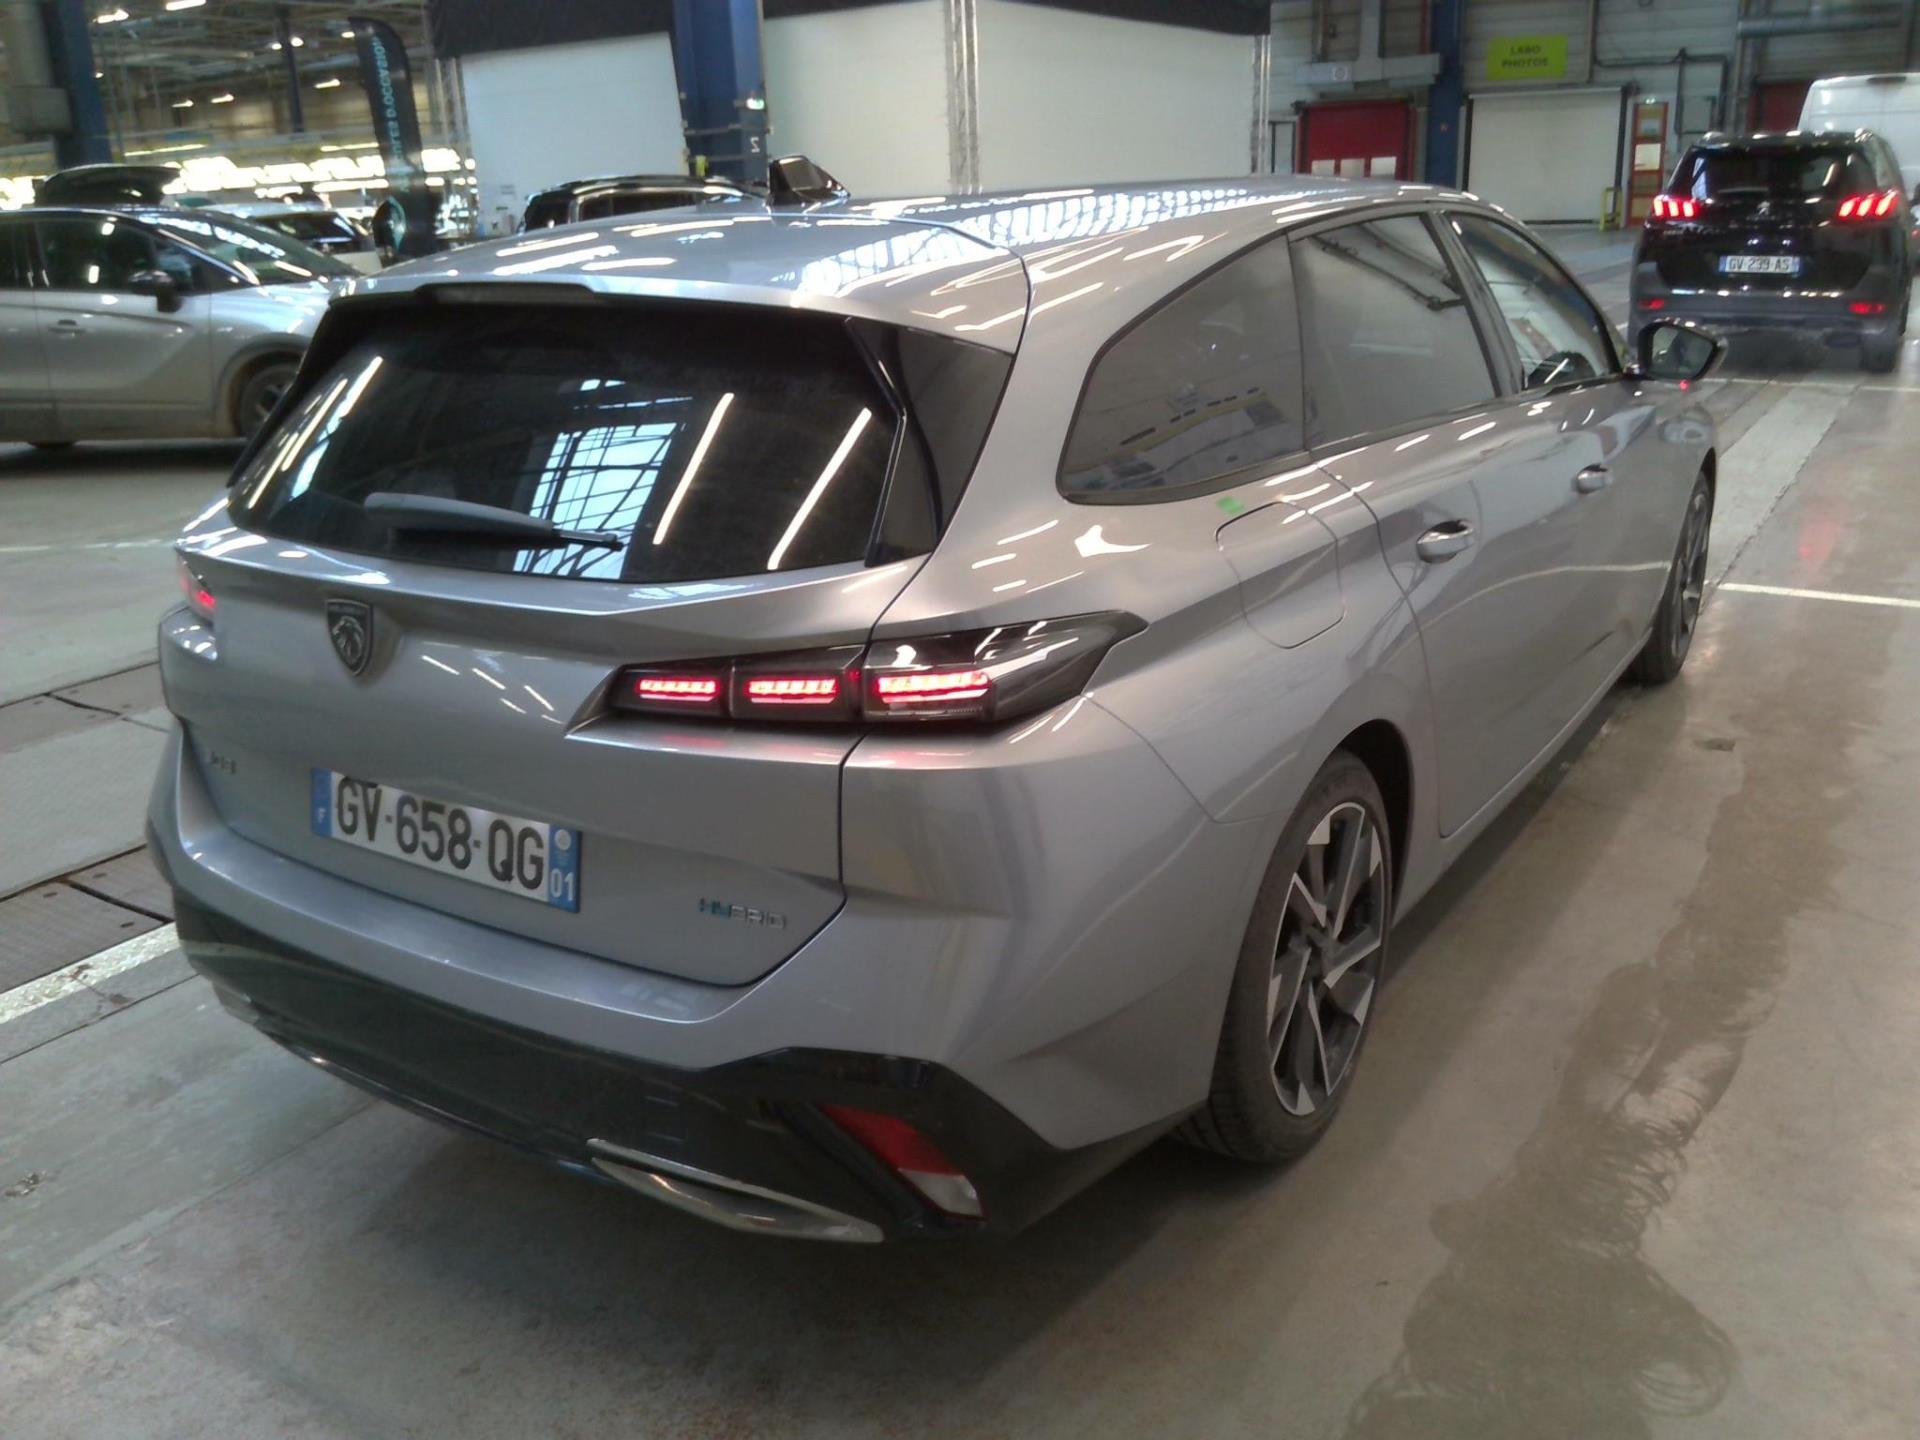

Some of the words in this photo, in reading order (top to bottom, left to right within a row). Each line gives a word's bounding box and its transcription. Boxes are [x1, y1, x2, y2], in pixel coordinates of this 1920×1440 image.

[1510, 45, 1541, 56] LABO
[1502, 57, 1548, 69] PHOTOS
[337, 776, 545, 890] GV-658-QG
[550, 868, 576, 901] 01
